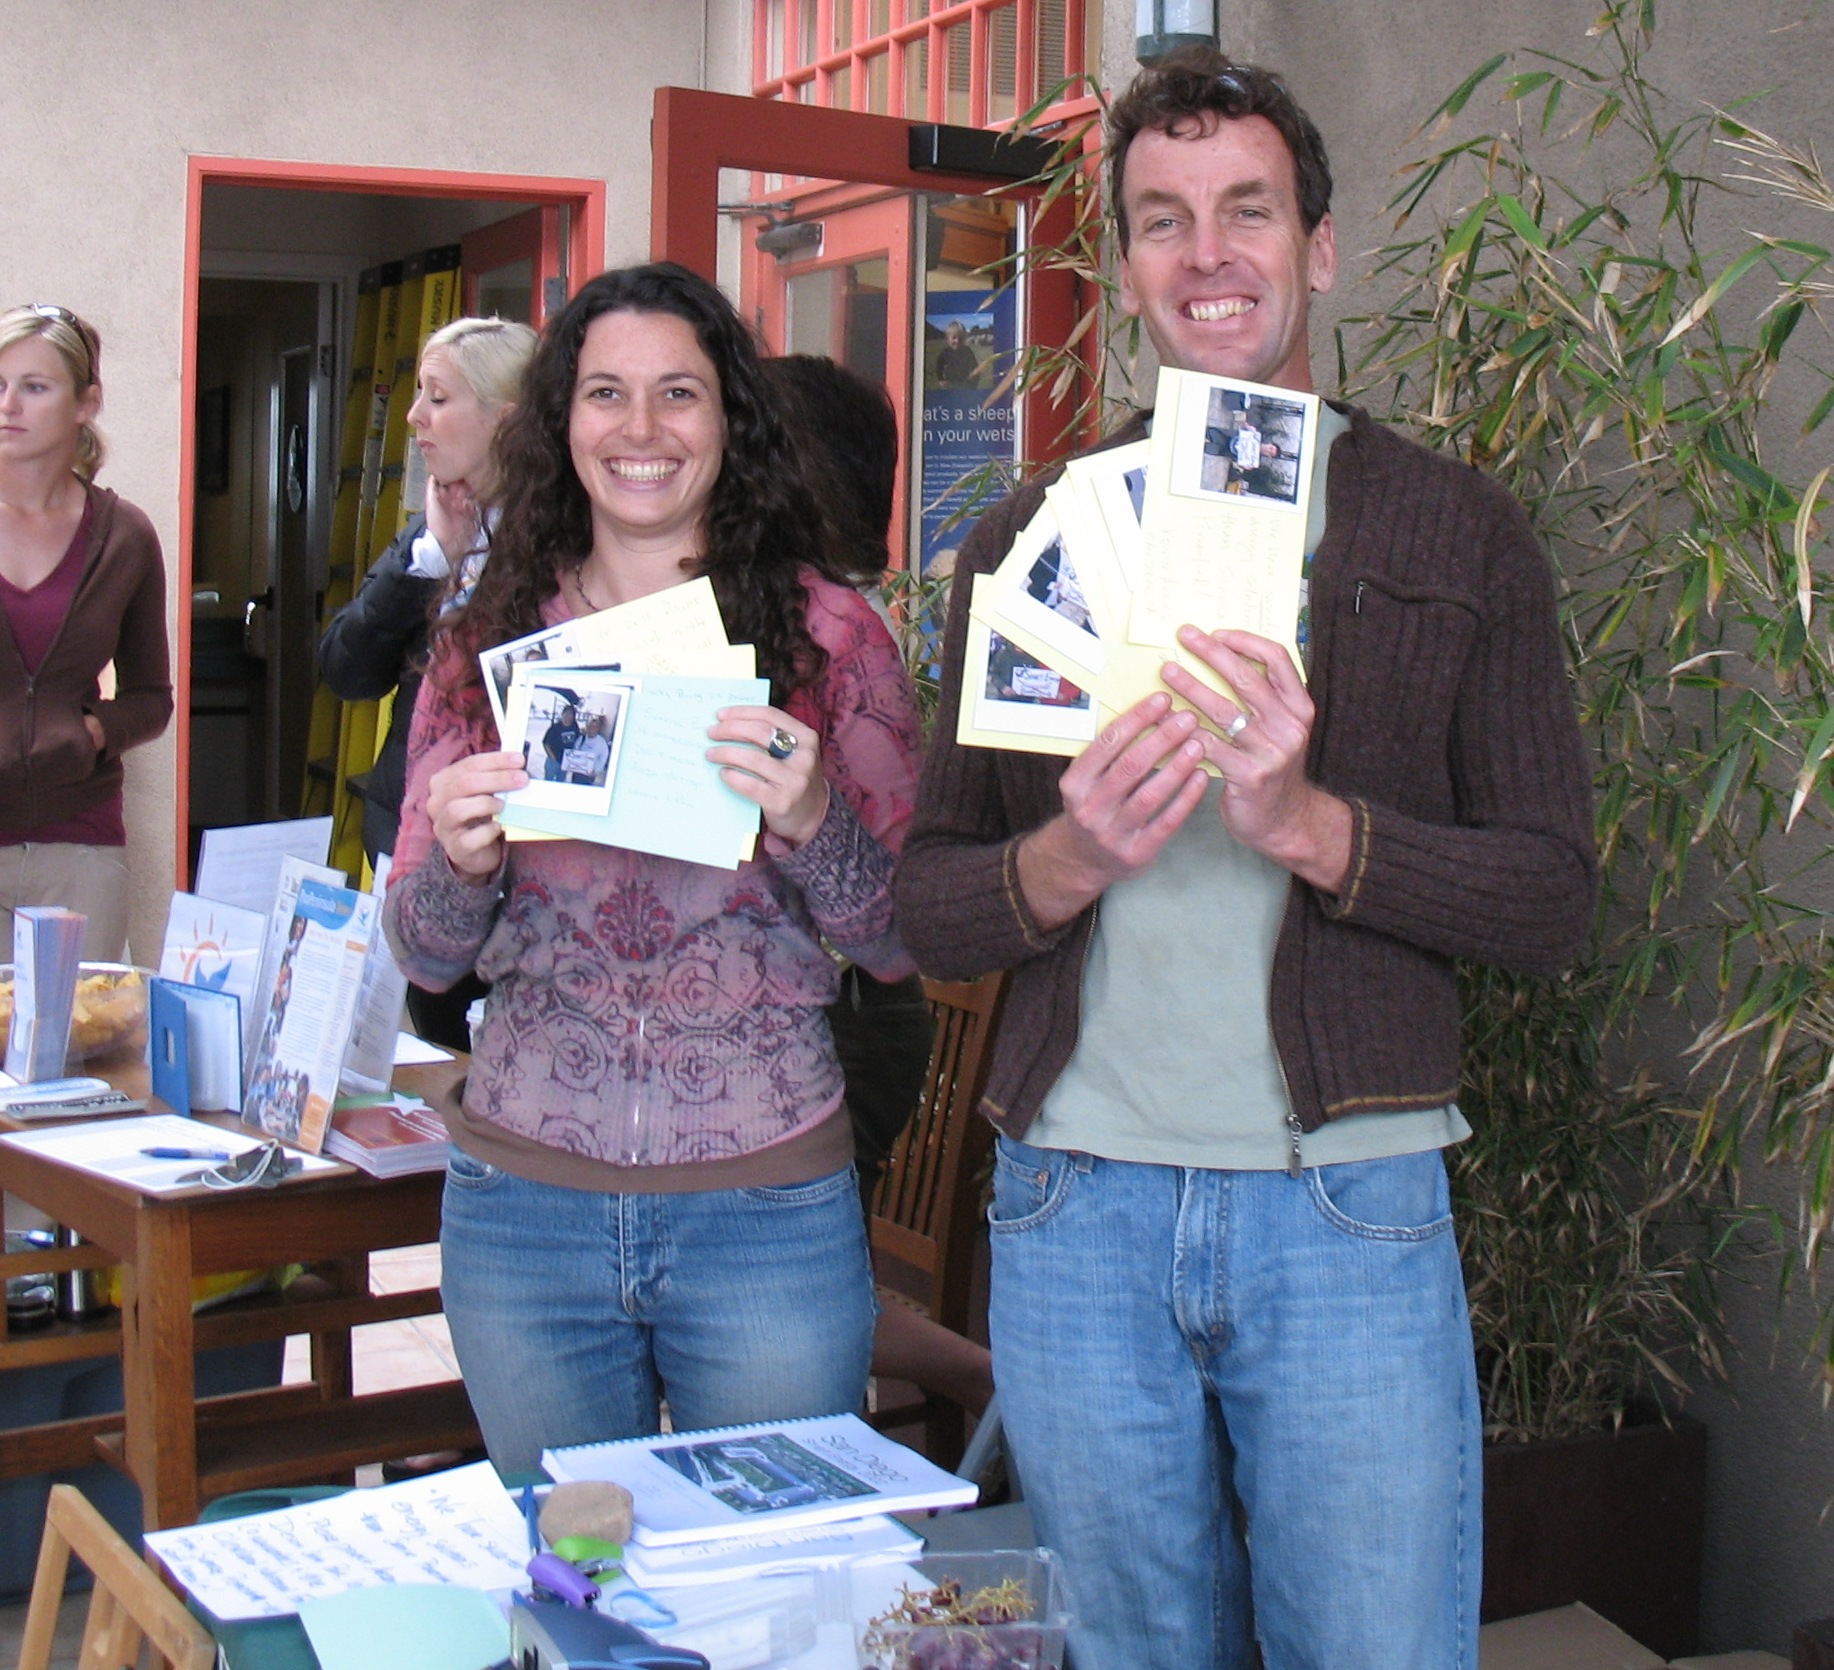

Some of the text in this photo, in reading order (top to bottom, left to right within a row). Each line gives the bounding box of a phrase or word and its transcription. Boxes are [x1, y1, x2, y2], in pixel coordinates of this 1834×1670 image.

[924, 404, 1014, 423] at's a sheep
[924, 427, 1014, 445] n your wets
